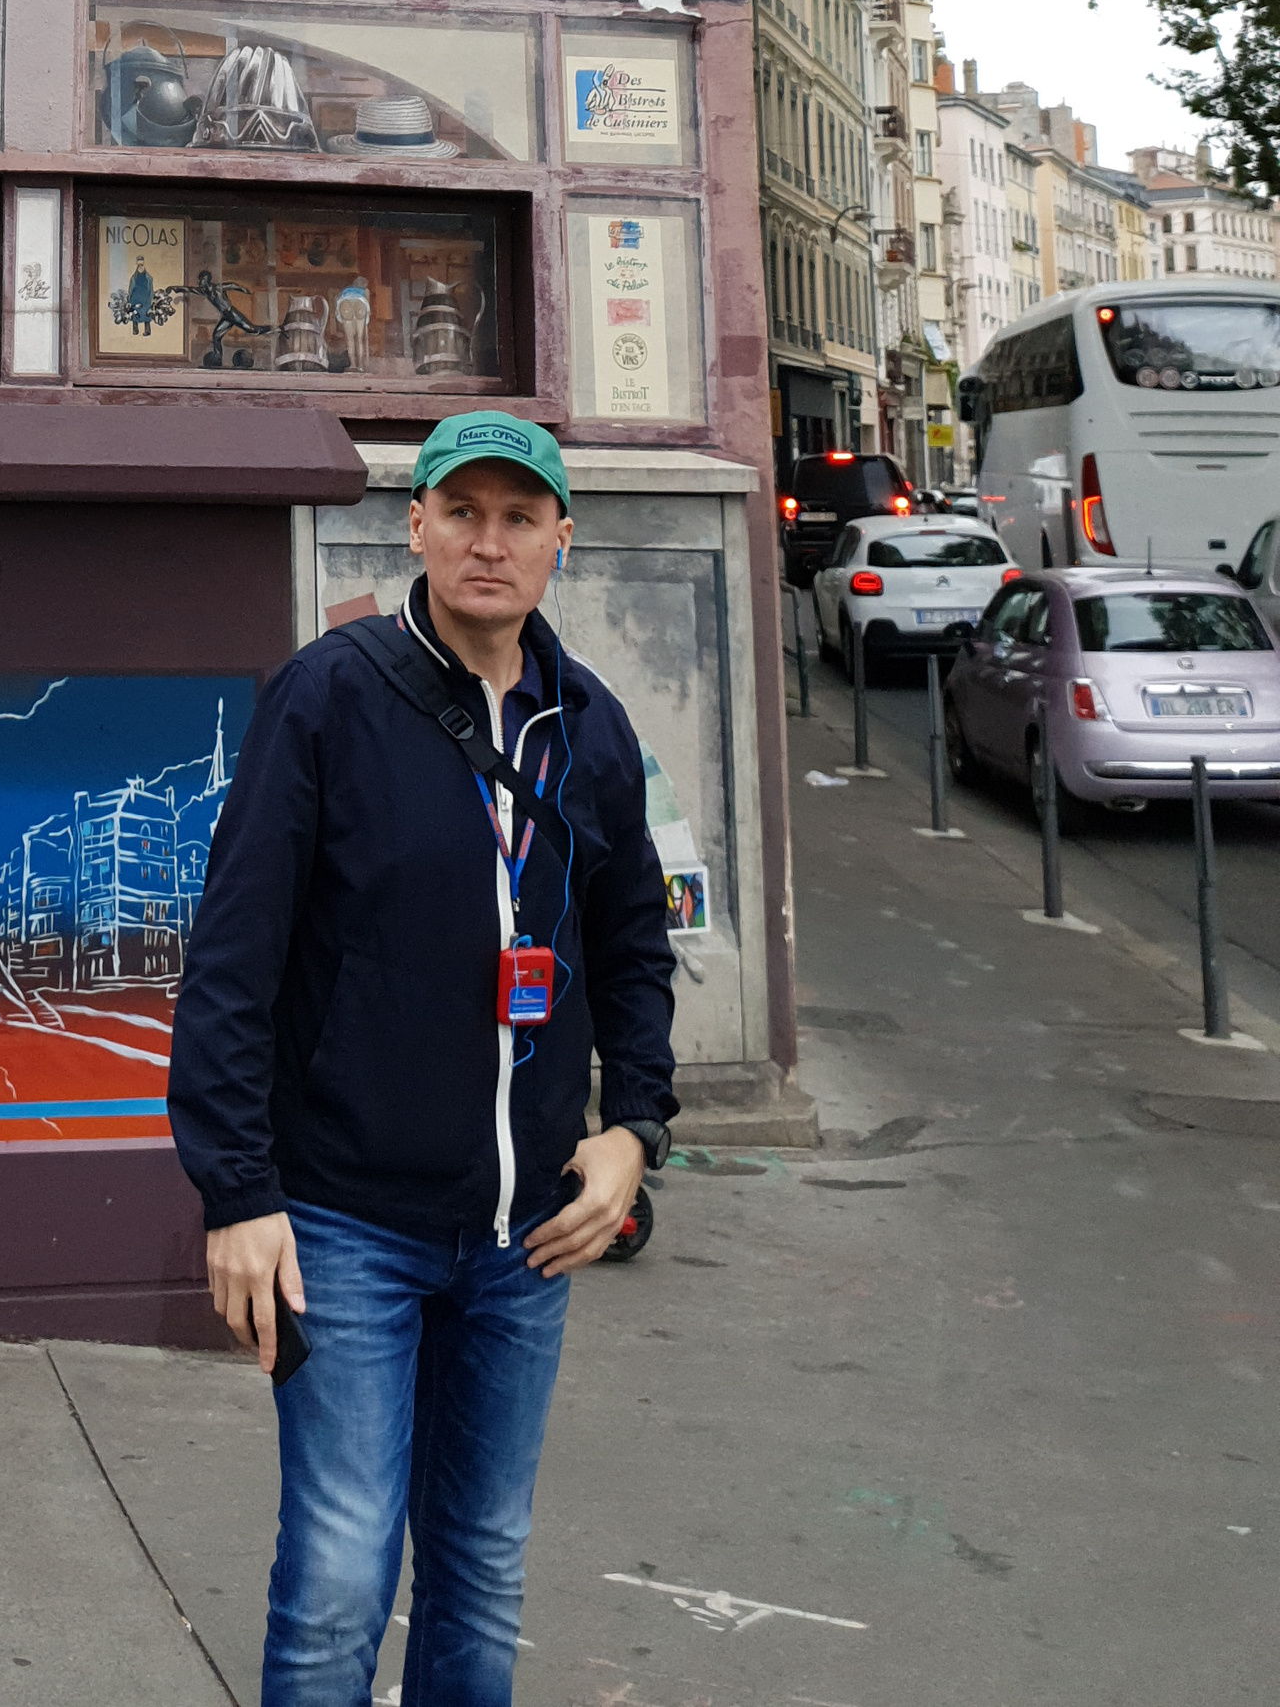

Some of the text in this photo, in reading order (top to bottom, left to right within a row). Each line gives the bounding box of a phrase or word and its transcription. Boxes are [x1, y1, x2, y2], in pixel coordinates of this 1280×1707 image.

[617, 73, 642, 86] Des
[618, 93, 666, 108] Bistrots
[584, 114, 668, 129] de Cuisiniers
[106, 223, 178, 247] NICOLAS
[621, 355, 639, 366] VINS
[625, 378, 636, 387] LE
[463, 429, 527, 448] Marc O'Polo
